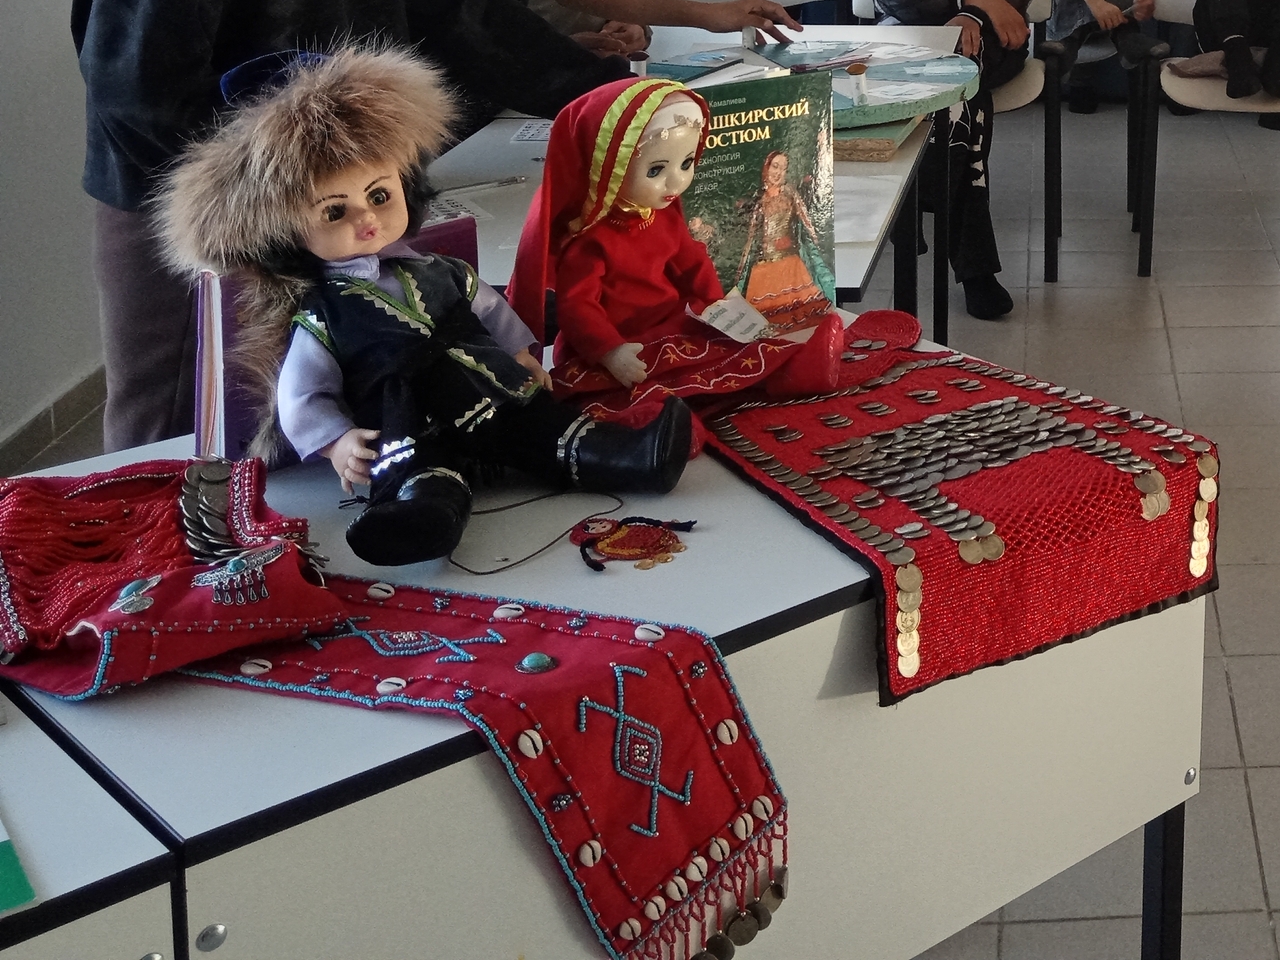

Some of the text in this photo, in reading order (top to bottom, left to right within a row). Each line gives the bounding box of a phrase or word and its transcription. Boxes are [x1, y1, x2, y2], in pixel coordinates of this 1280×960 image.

[709, 97, 746, 107] Камалиева
[709, 97, 809, 130] ШКИРСКИЙ
[704, 126, 771, 149] ОСТЮМ
[697, 151, 741, 166] ЕХНОЛОГИЯ
